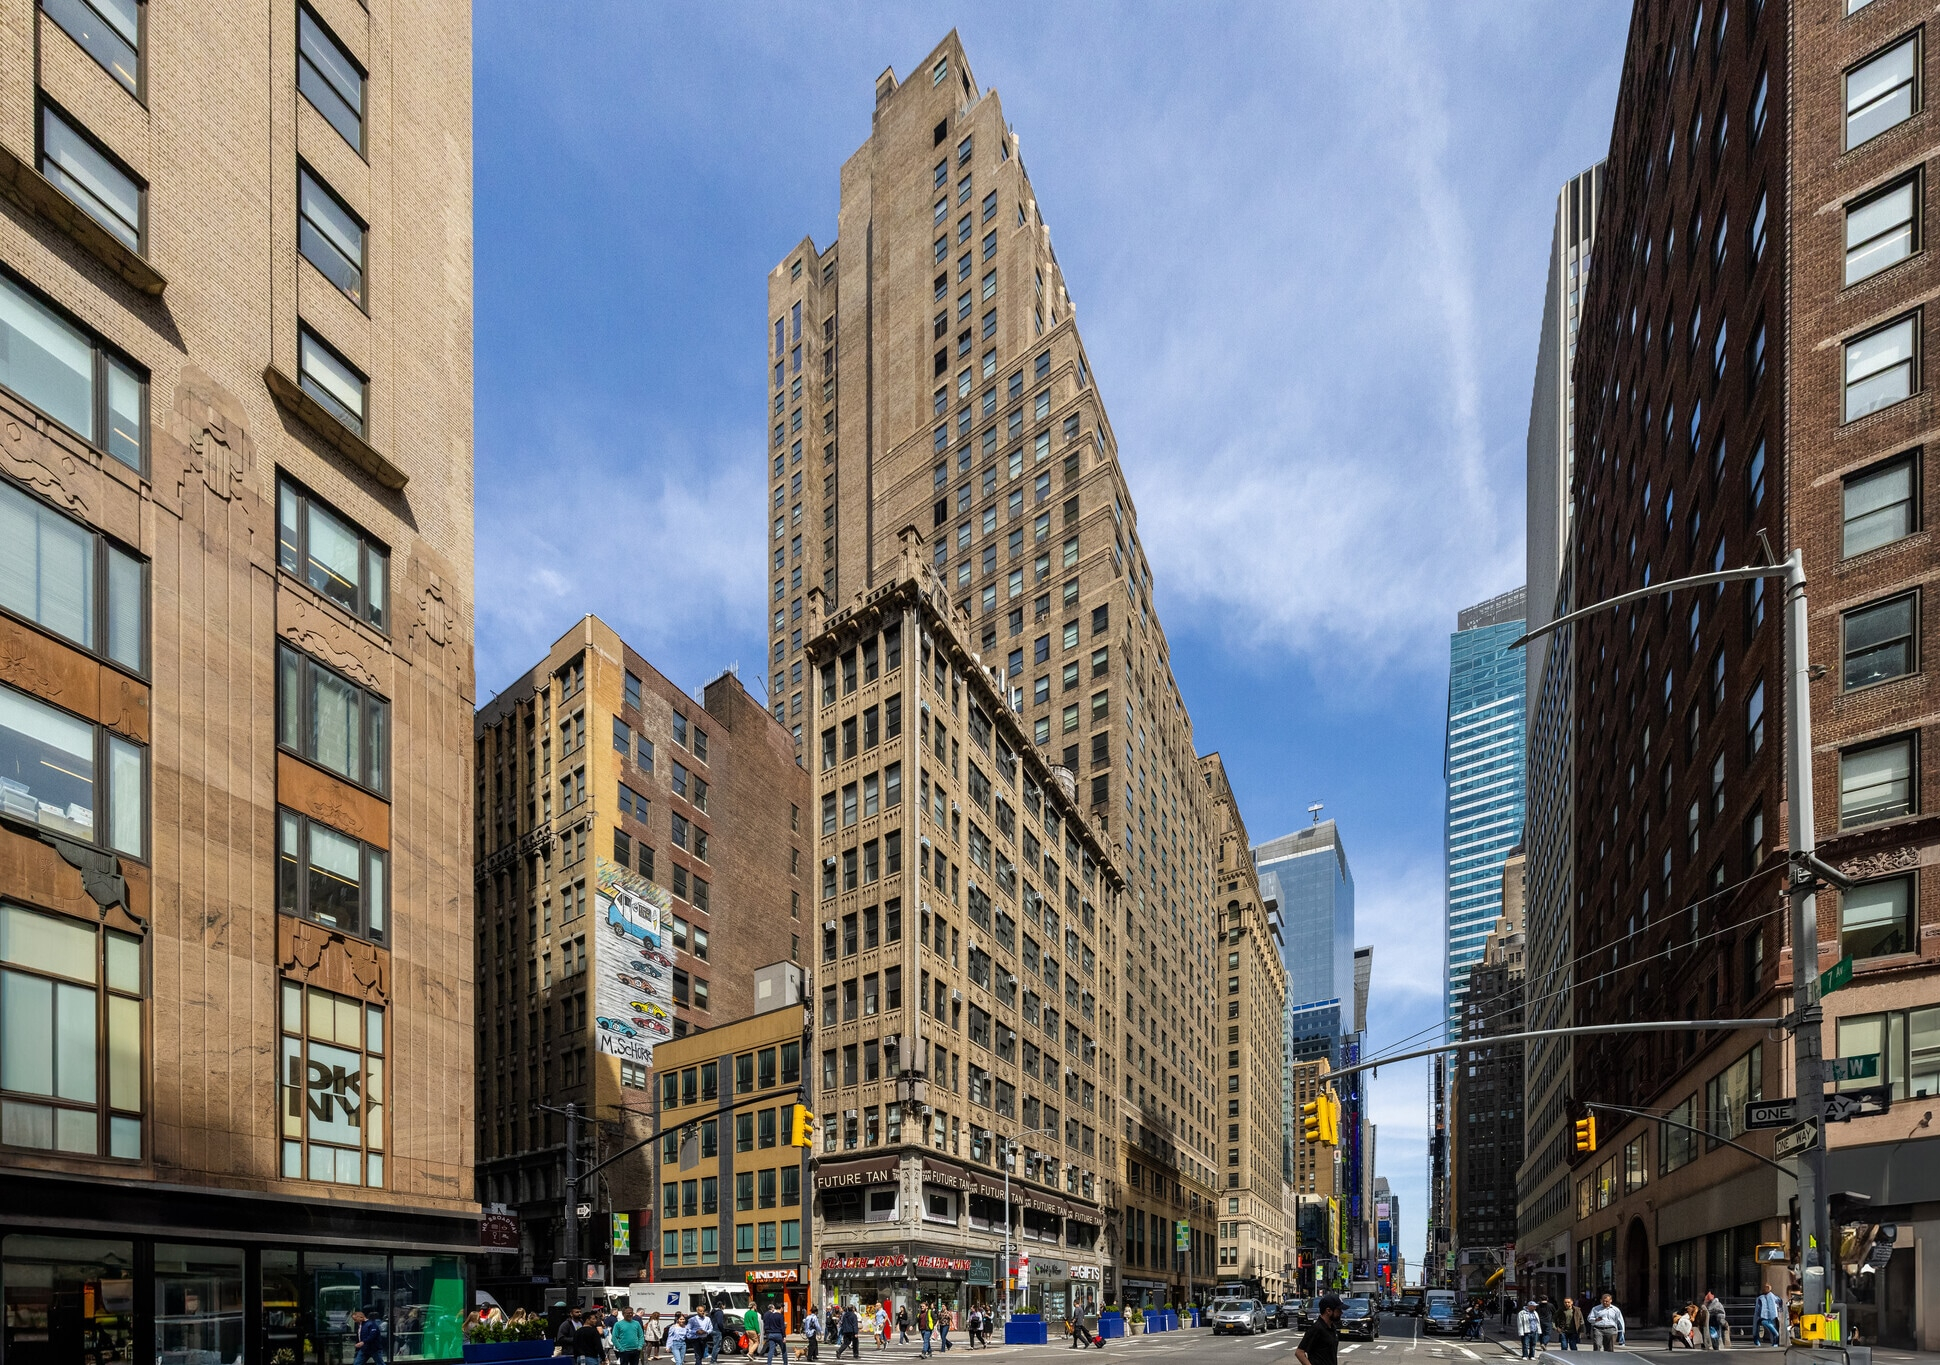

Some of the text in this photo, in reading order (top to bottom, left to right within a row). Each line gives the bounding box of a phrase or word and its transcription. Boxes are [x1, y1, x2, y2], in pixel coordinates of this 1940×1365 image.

[1828, 971, 1833, 989] 7
[1850, 1059, 1864, 1076] W
[1756, 1101, 1850, 1121] ONE AY
[1777, 1128, 1812, 1152] ONE WAY
[818, 1170, 888, 1188] FUTURE TAN
[932, 1171, 970, 1190] FUTURE TAN
[981, 1184, 1024, 1204] FUTUR TAN
[1034, 1200, 1067, 1216] FUTURE TAN
[488, 1216, 517, 1233] BROADWAY
[1074, 1212, 1103, 1226] FUTURE TAN
[820, 1254, 905, 1269] HEALTH KING
[917, 1255, 971, 1270] HEALTH KING
[756, 1269, 797, 1279] INDICA
[1079, 1265, 1099, 1280] GIFTS
